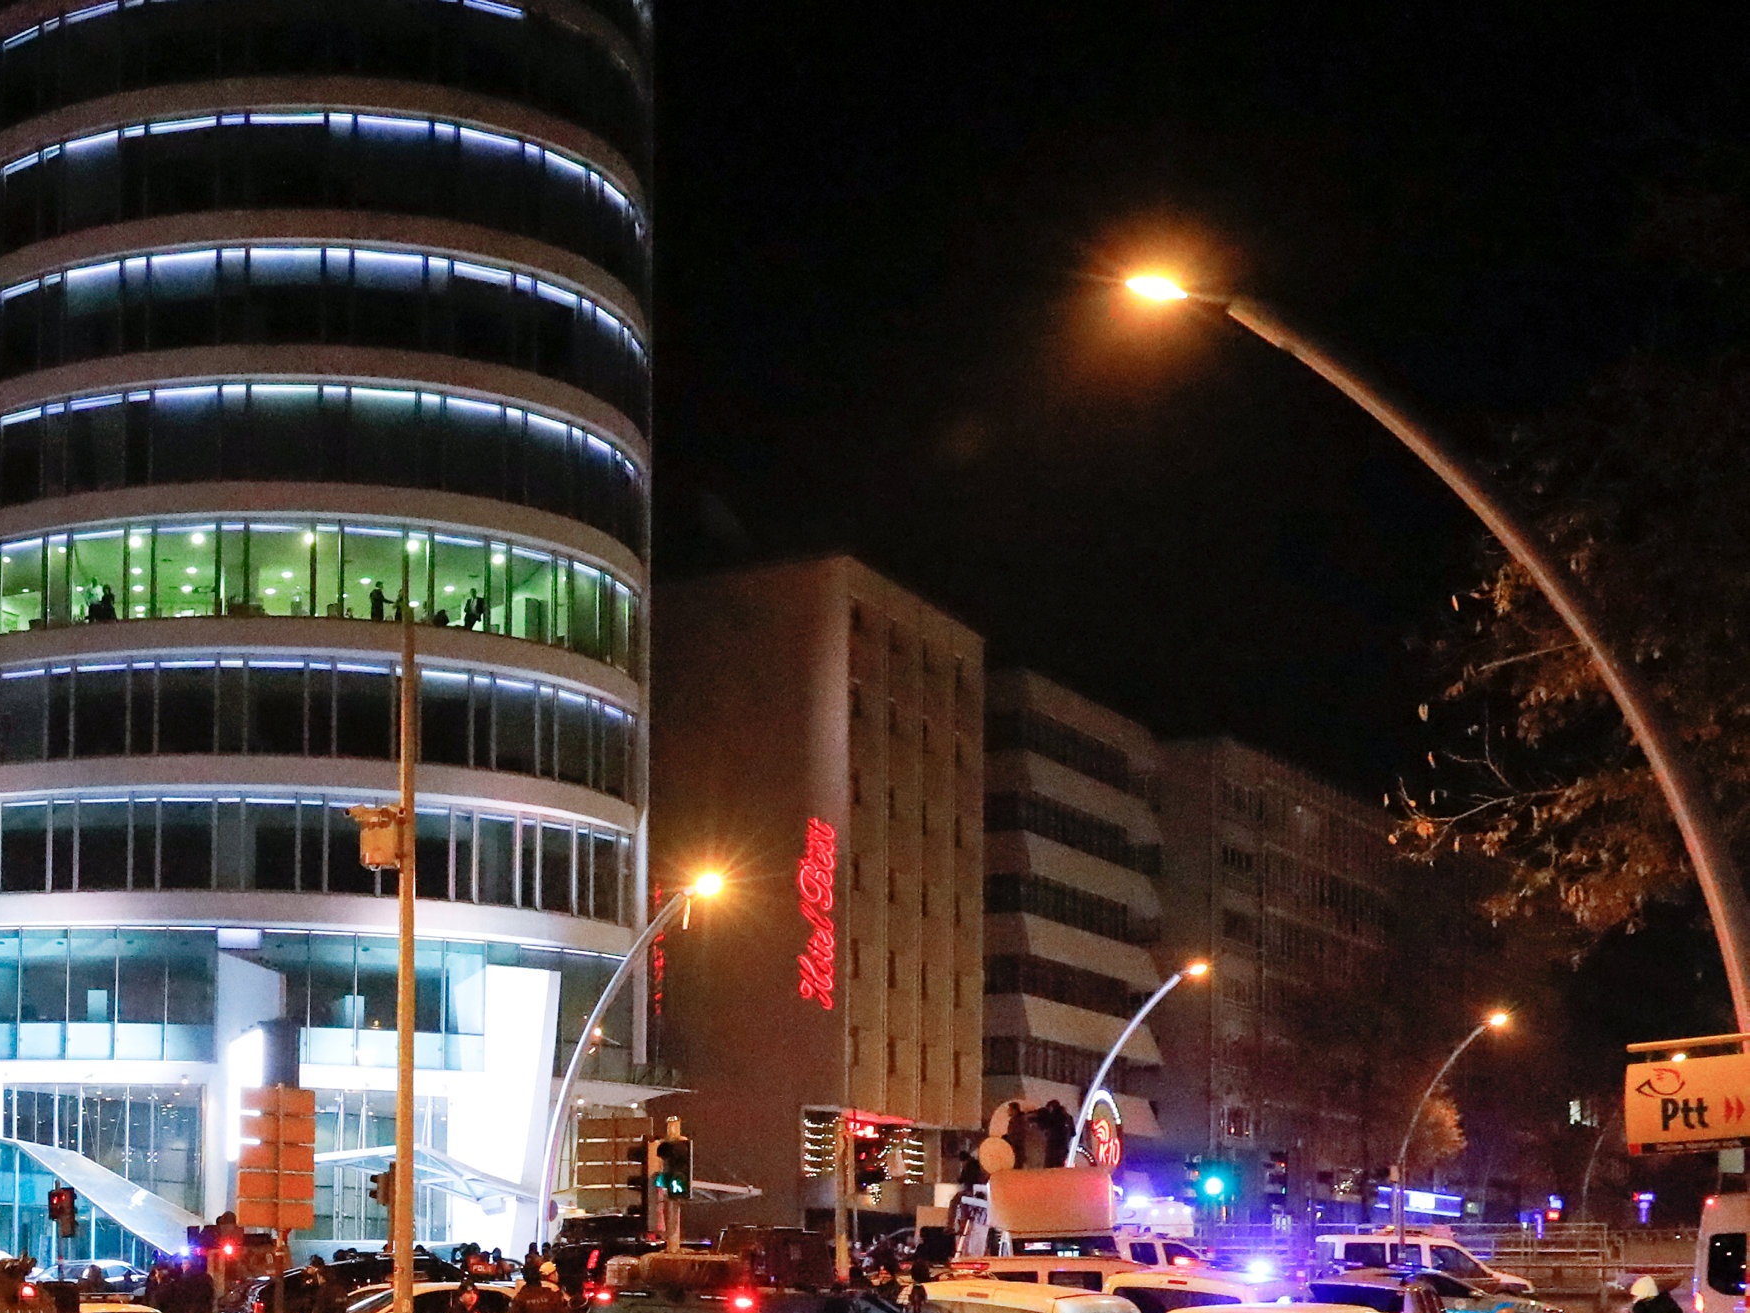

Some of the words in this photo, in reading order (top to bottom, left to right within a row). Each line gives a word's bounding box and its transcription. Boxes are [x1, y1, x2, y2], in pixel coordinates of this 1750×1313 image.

[797, 817, 836, 910] Best
[797, 902, 835, 1010] Hotel
[1661, 1098, 1709, 1131] Ptt
